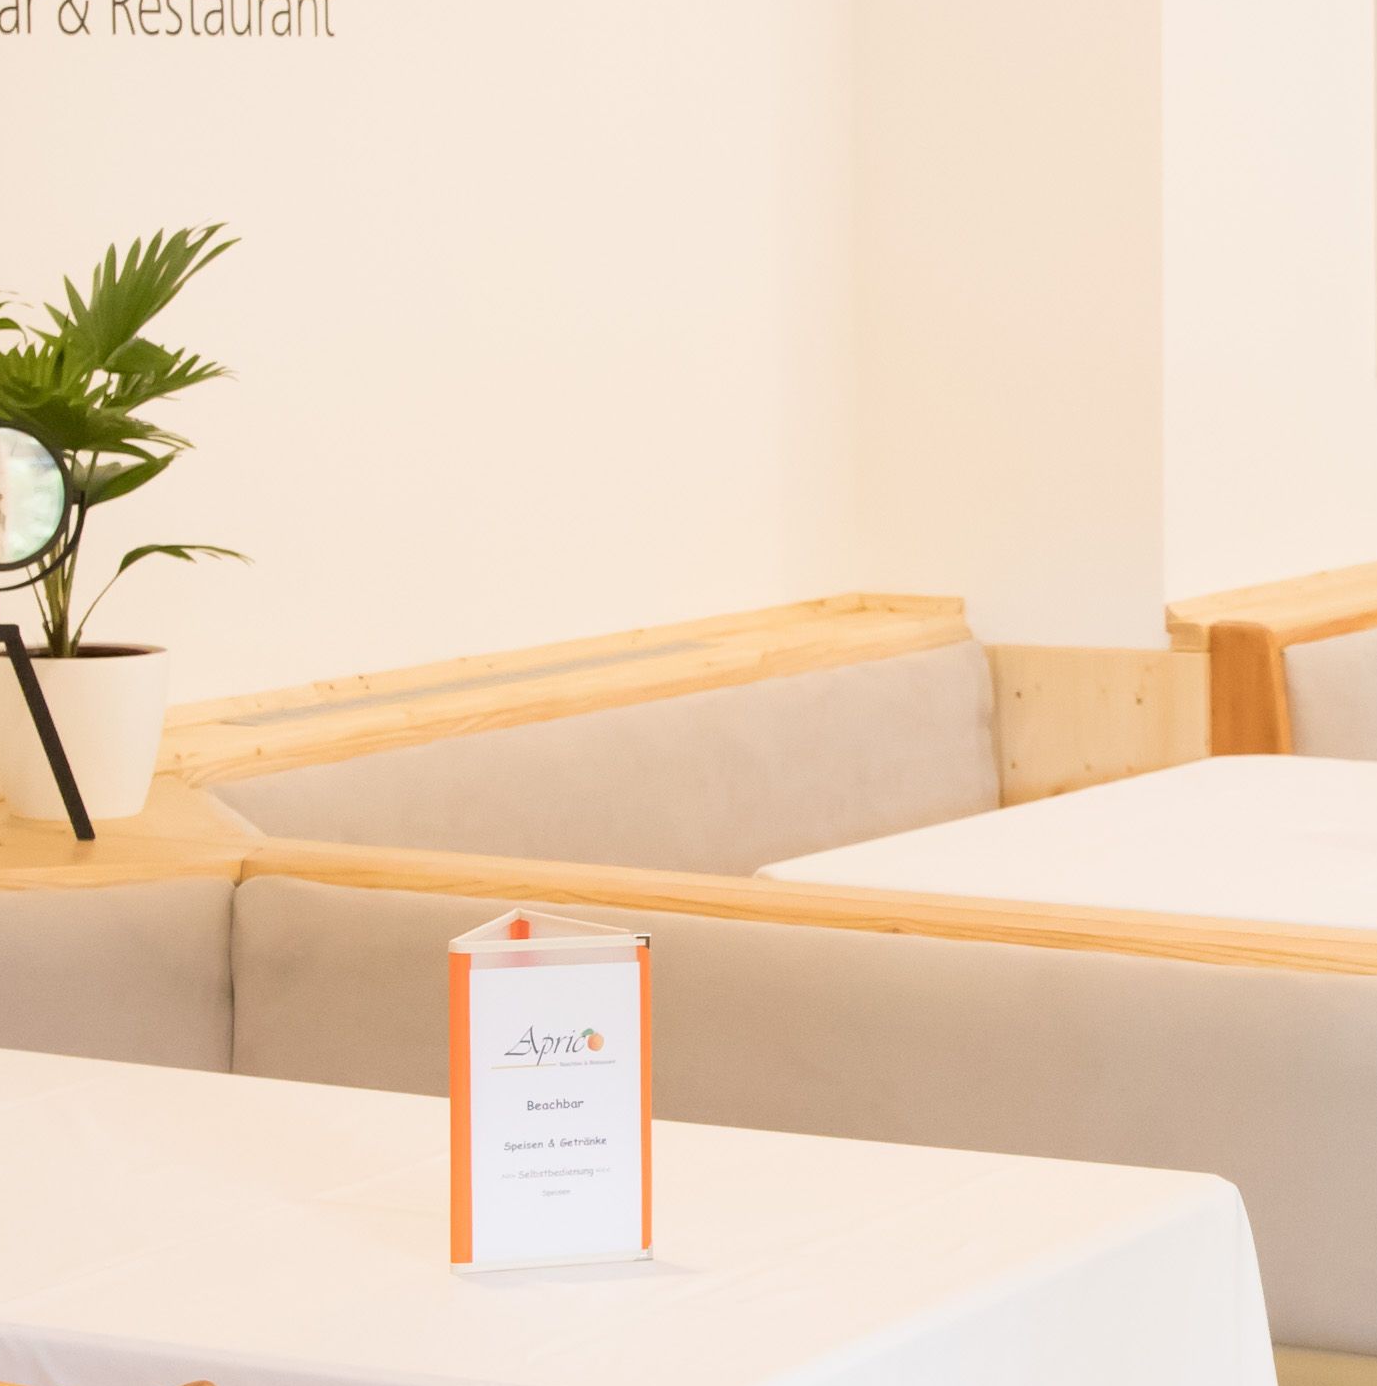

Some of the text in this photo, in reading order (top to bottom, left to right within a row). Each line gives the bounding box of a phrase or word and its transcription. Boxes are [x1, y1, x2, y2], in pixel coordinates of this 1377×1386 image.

[526, 1098, 584, 1111] Beachbar
[503, 1136, 607, 1152] Speisen & Getränke
